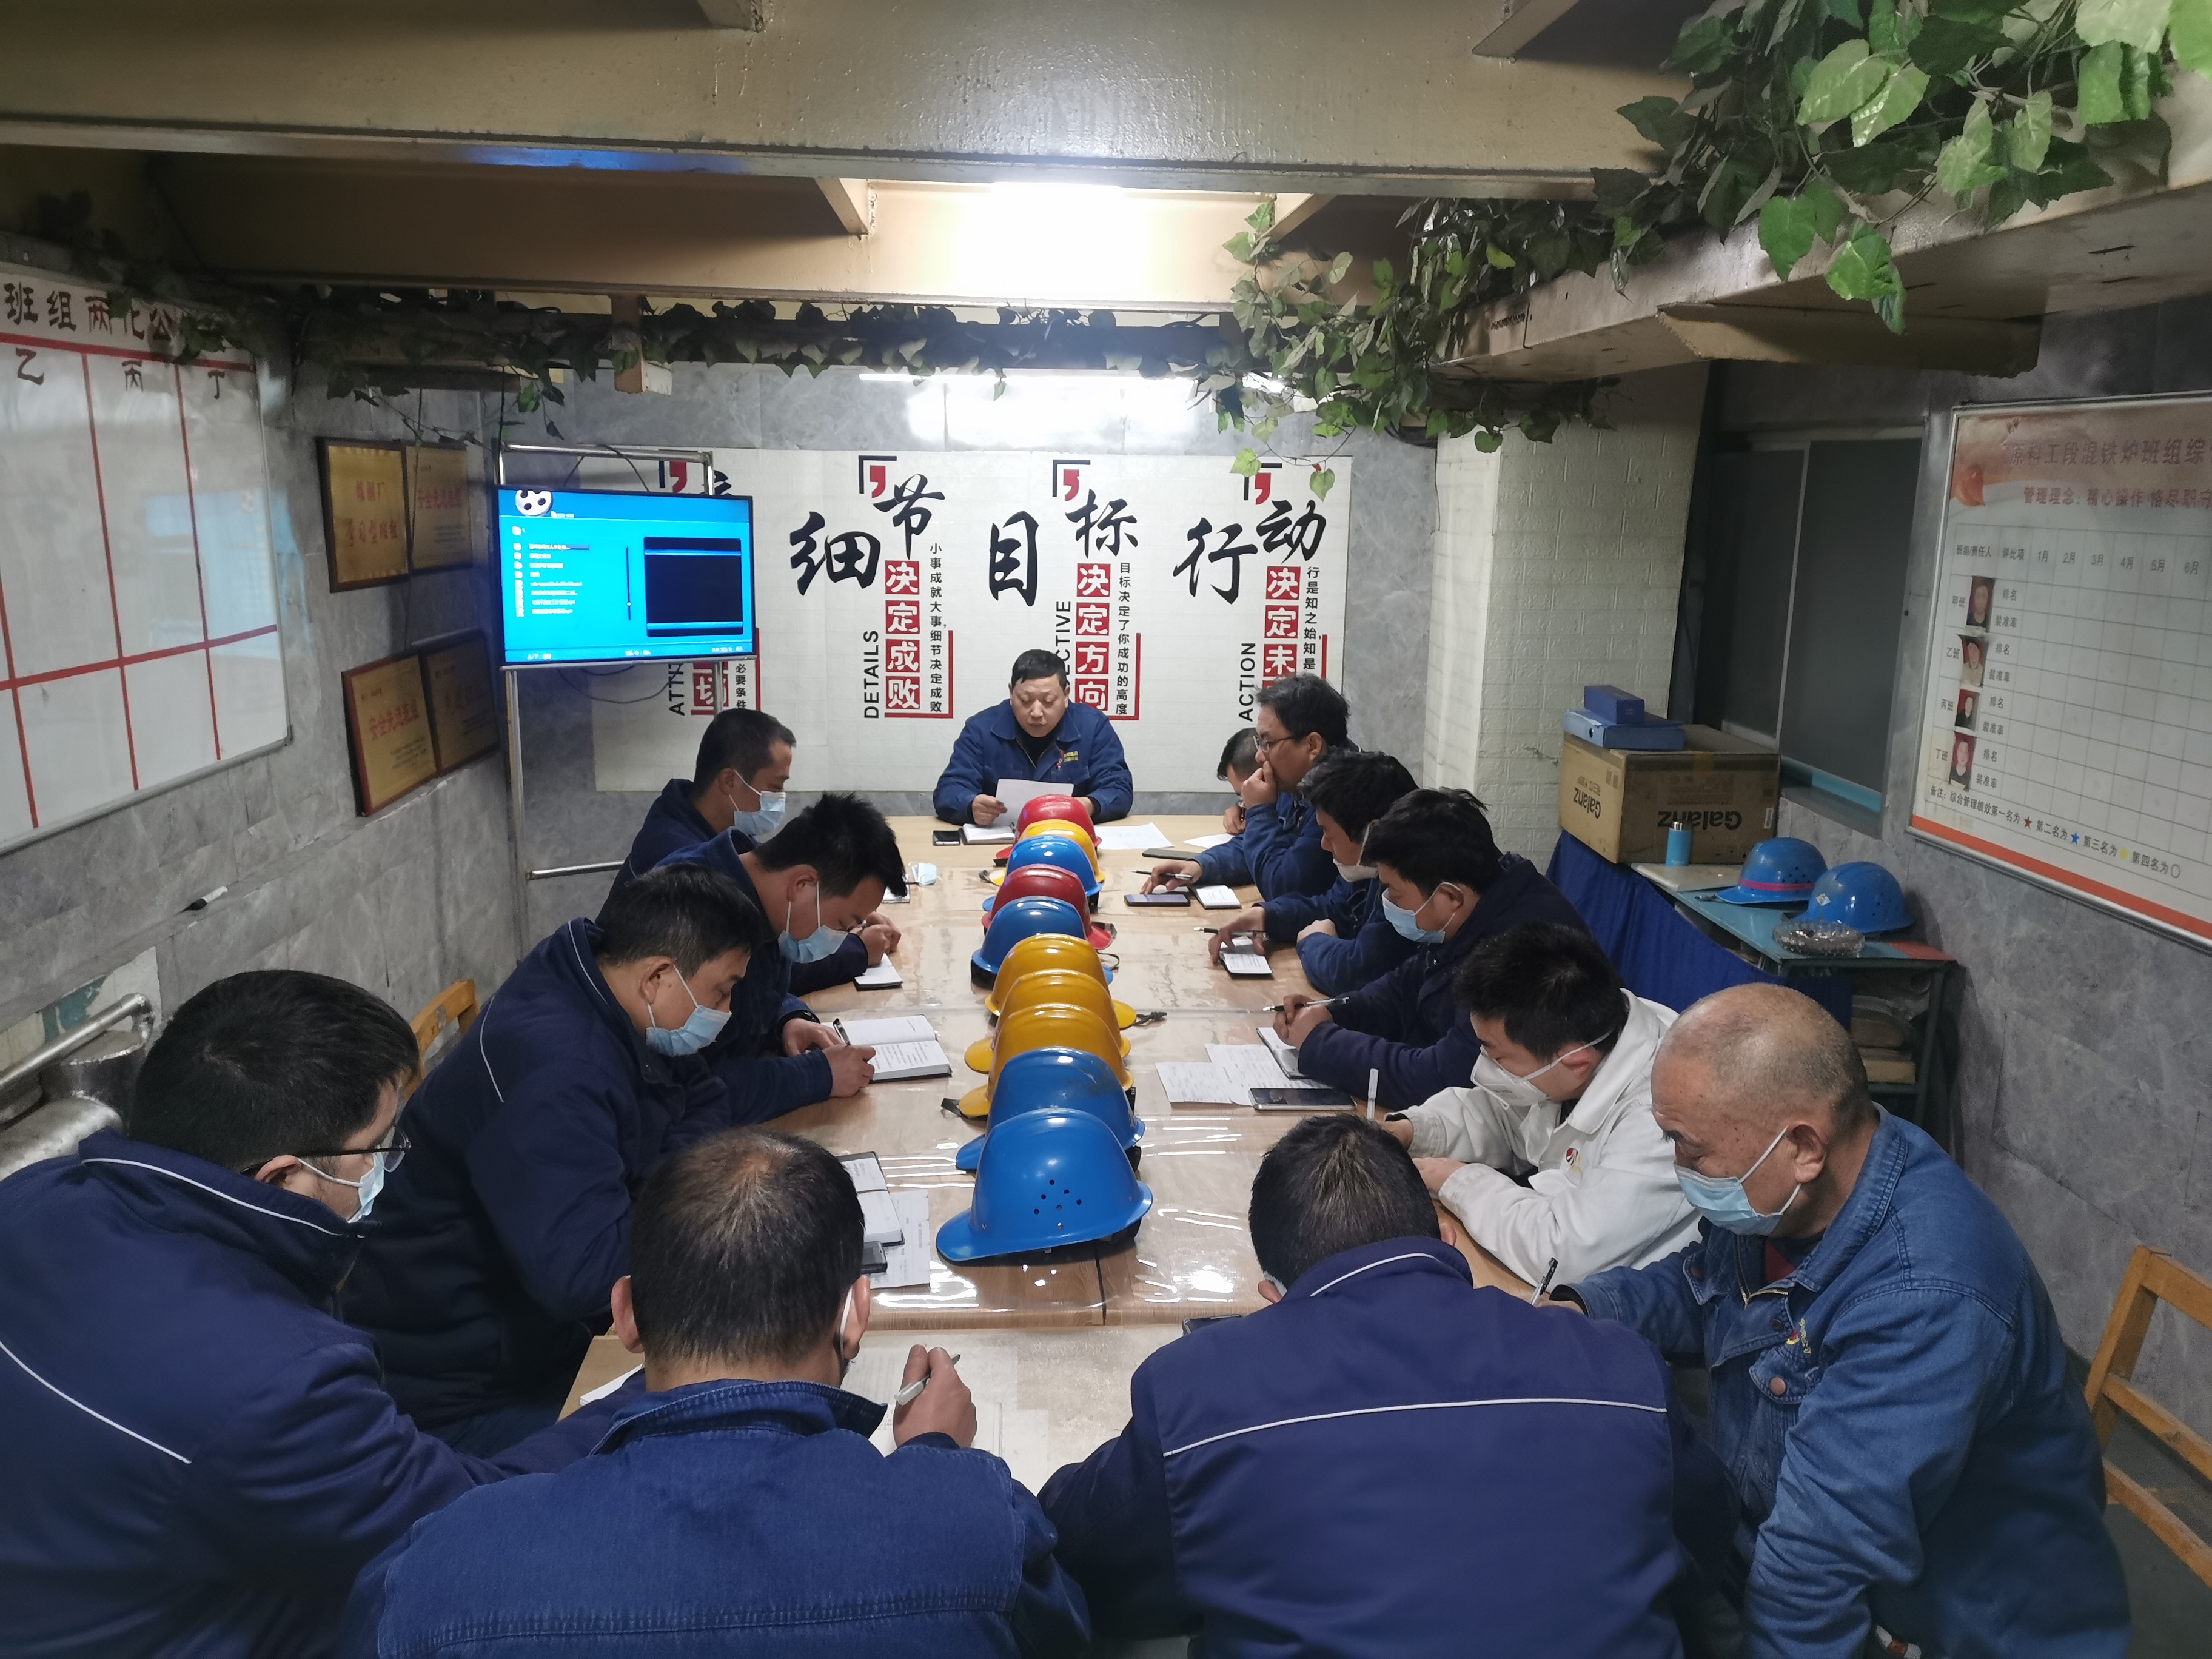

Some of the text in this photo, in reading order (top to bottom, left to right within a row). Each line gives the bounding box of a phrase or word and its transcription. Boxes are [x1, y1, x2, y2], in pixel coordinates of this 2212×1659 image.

[3, 281, 187, 341] 班组两化公
[15, 348, 45, 386] 乙
[121, 360, 144, 393] 丙
[207, 370, 225, 400] 丁
[2008, 437, 2212, 466] 原料工段混铁炉班组综
[2037, 549, 2049, 563] 1月
[2063, 552, 2076, 565] 2月
[2091, 554, 2105, 567] 3月
[2120, 556, 2134, 570] 4月
[2150, 558, 2166, 574] 5月
[2183, 561, 2200, 575] 6月
[886, 561, 920, 709] 决定成败
[1076, 563, 1111, 711] 决定方向
[1115, 561, 1131, 716] 目标决定了你成功的高度
[1263, 566, 1301, 689] 决定未
[863, 630, 879, 719] DETAILS
[1238, 643, 1256, 722] ACTION
[1572, 786, 1602, 820] Galanz
[1657, 810, 1743, 831] Galanz
